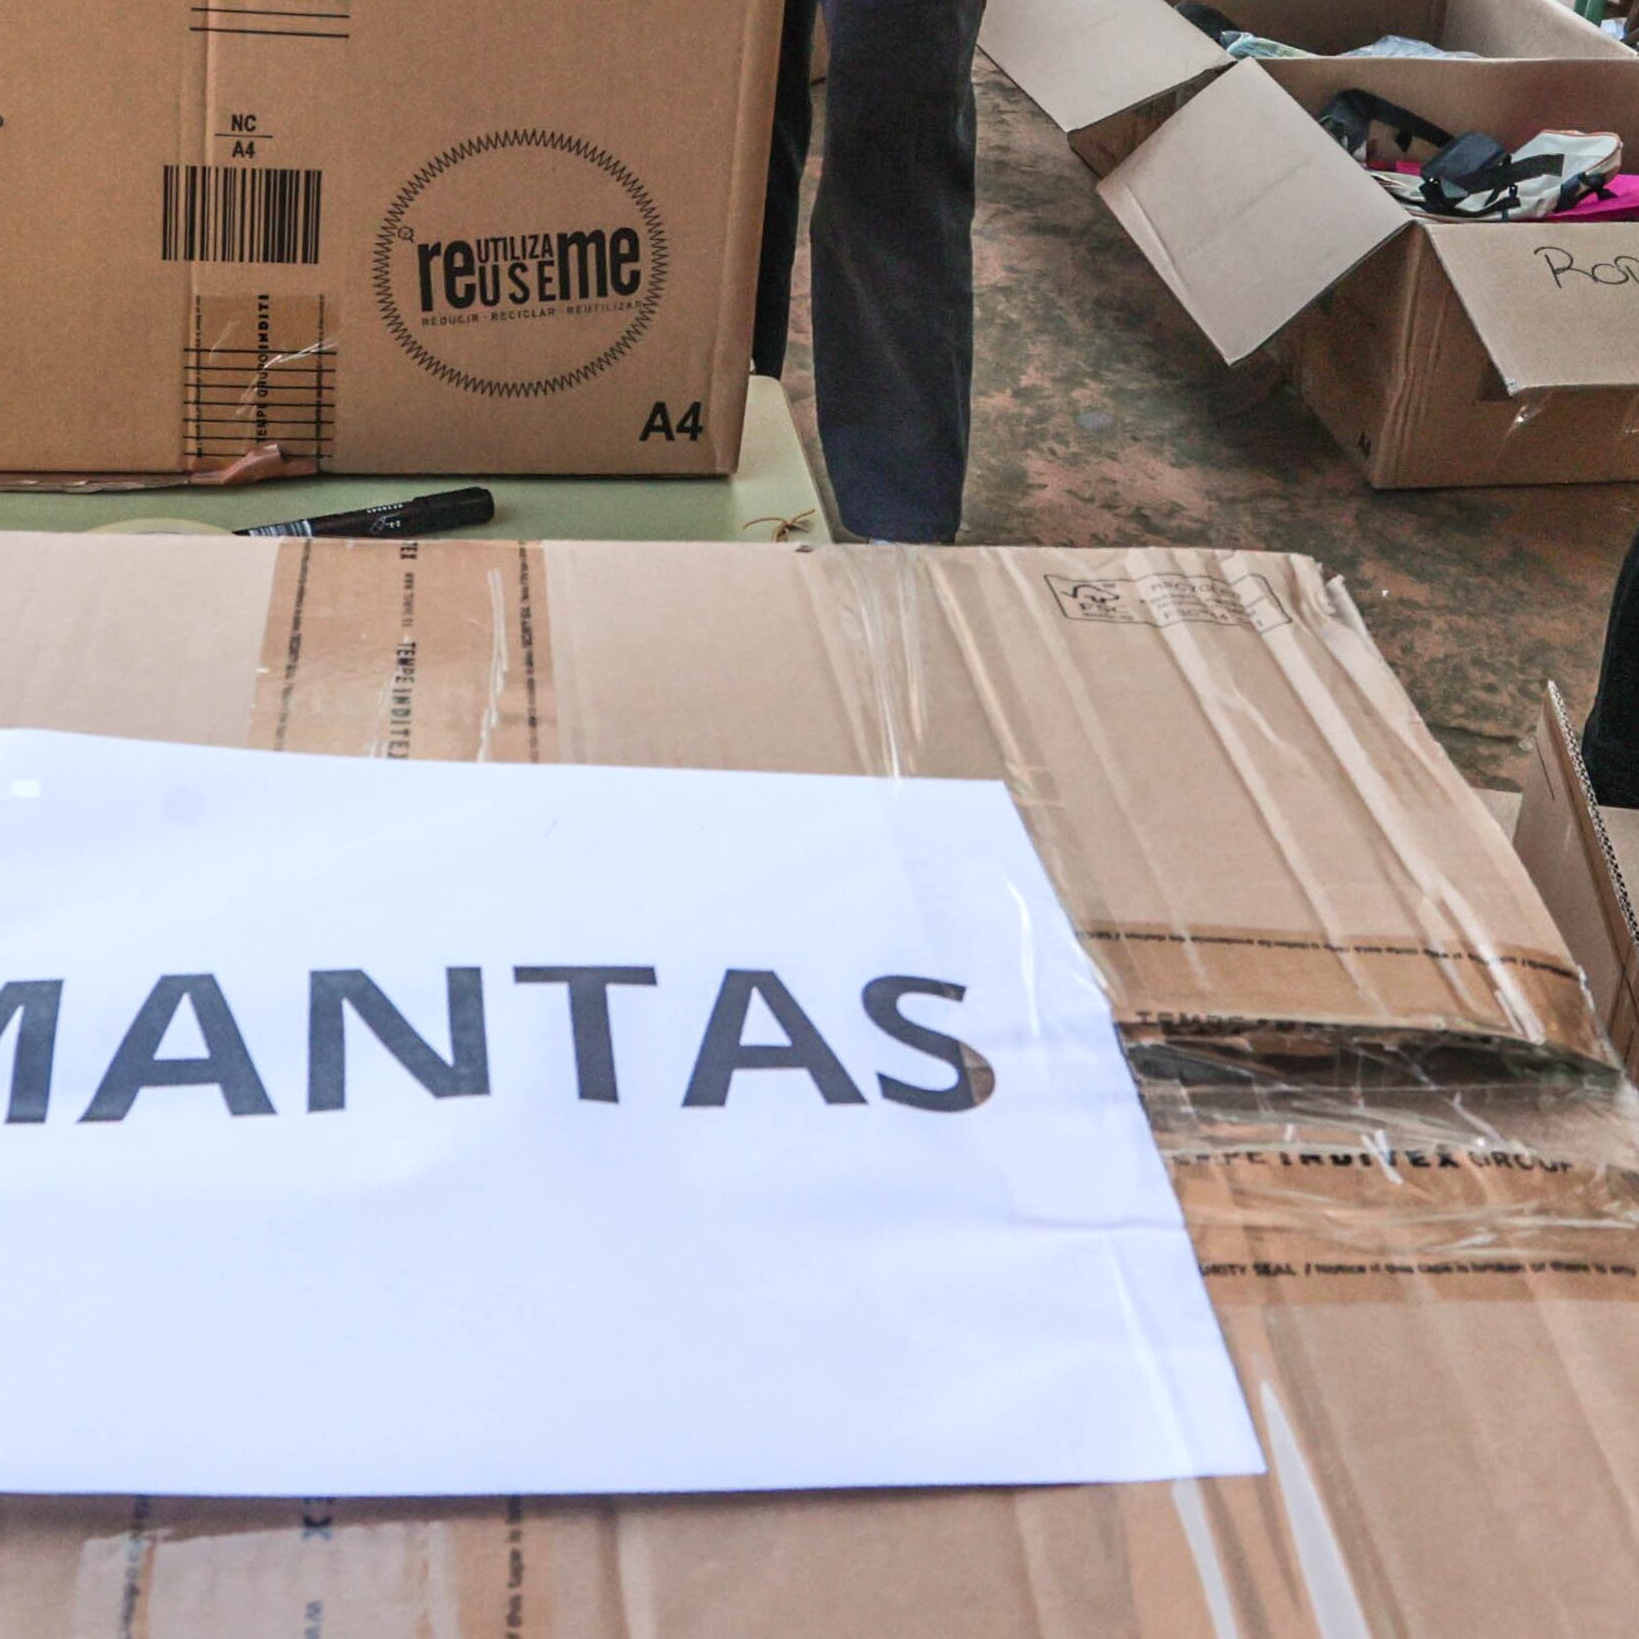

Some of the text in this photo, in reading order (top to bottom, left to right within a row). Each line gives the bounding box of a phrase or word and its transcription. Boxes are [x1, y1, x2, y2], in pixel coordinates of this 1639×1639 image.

[230, 113, 257, 132] NC
[231, 140, 256, 160] A4
[422, 300, 643, 328] REDUCIR RECICLAR REUTILIZAR
[639, 401, 704, 443] A4
[396, 640, 417, 684] TEMPE
